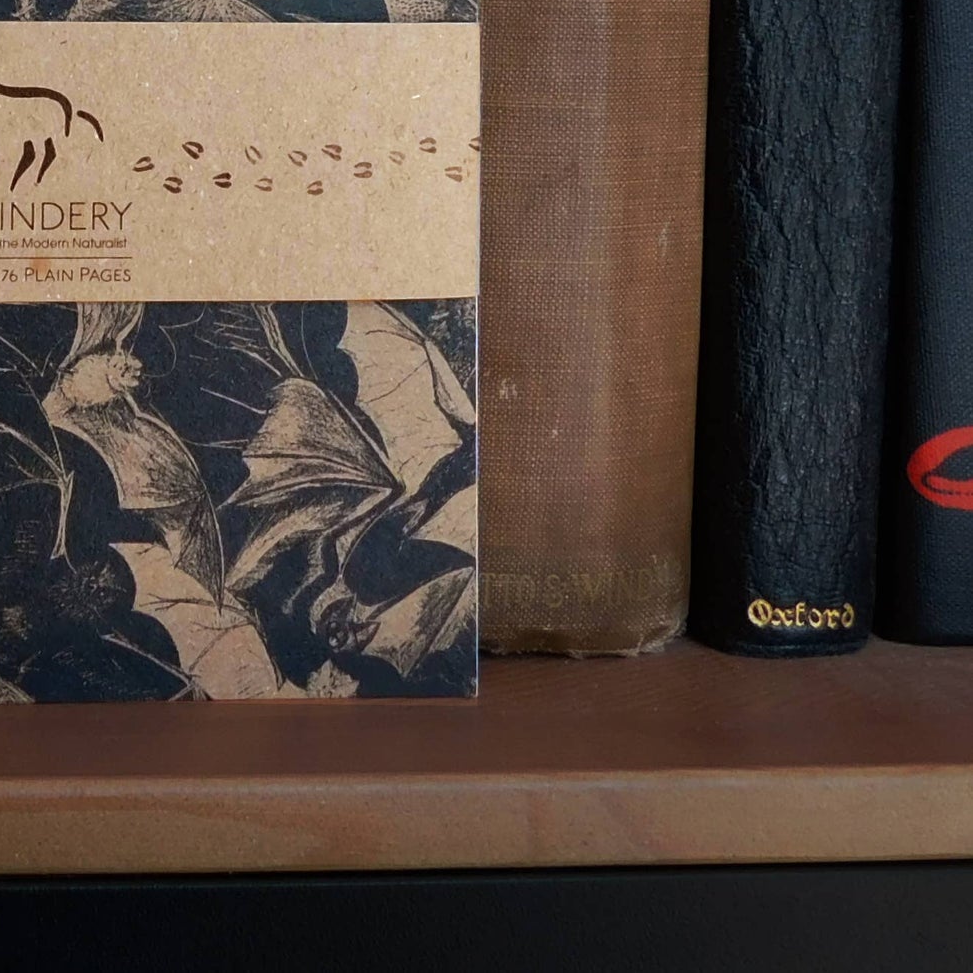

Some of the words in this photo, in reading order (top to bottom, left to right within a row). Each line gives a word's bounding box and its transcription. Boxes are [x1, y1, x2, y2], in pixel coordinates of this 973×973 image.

[22, 237, 69, 249] Modern
[72, 237, 128, 249] Naturalist
[1, 269, 18, 283] 76
[24, 267, 74, 282] PLAIN
[80, 267, 131, 282] PAGES
[747, 598, 855, 629] Oxford
